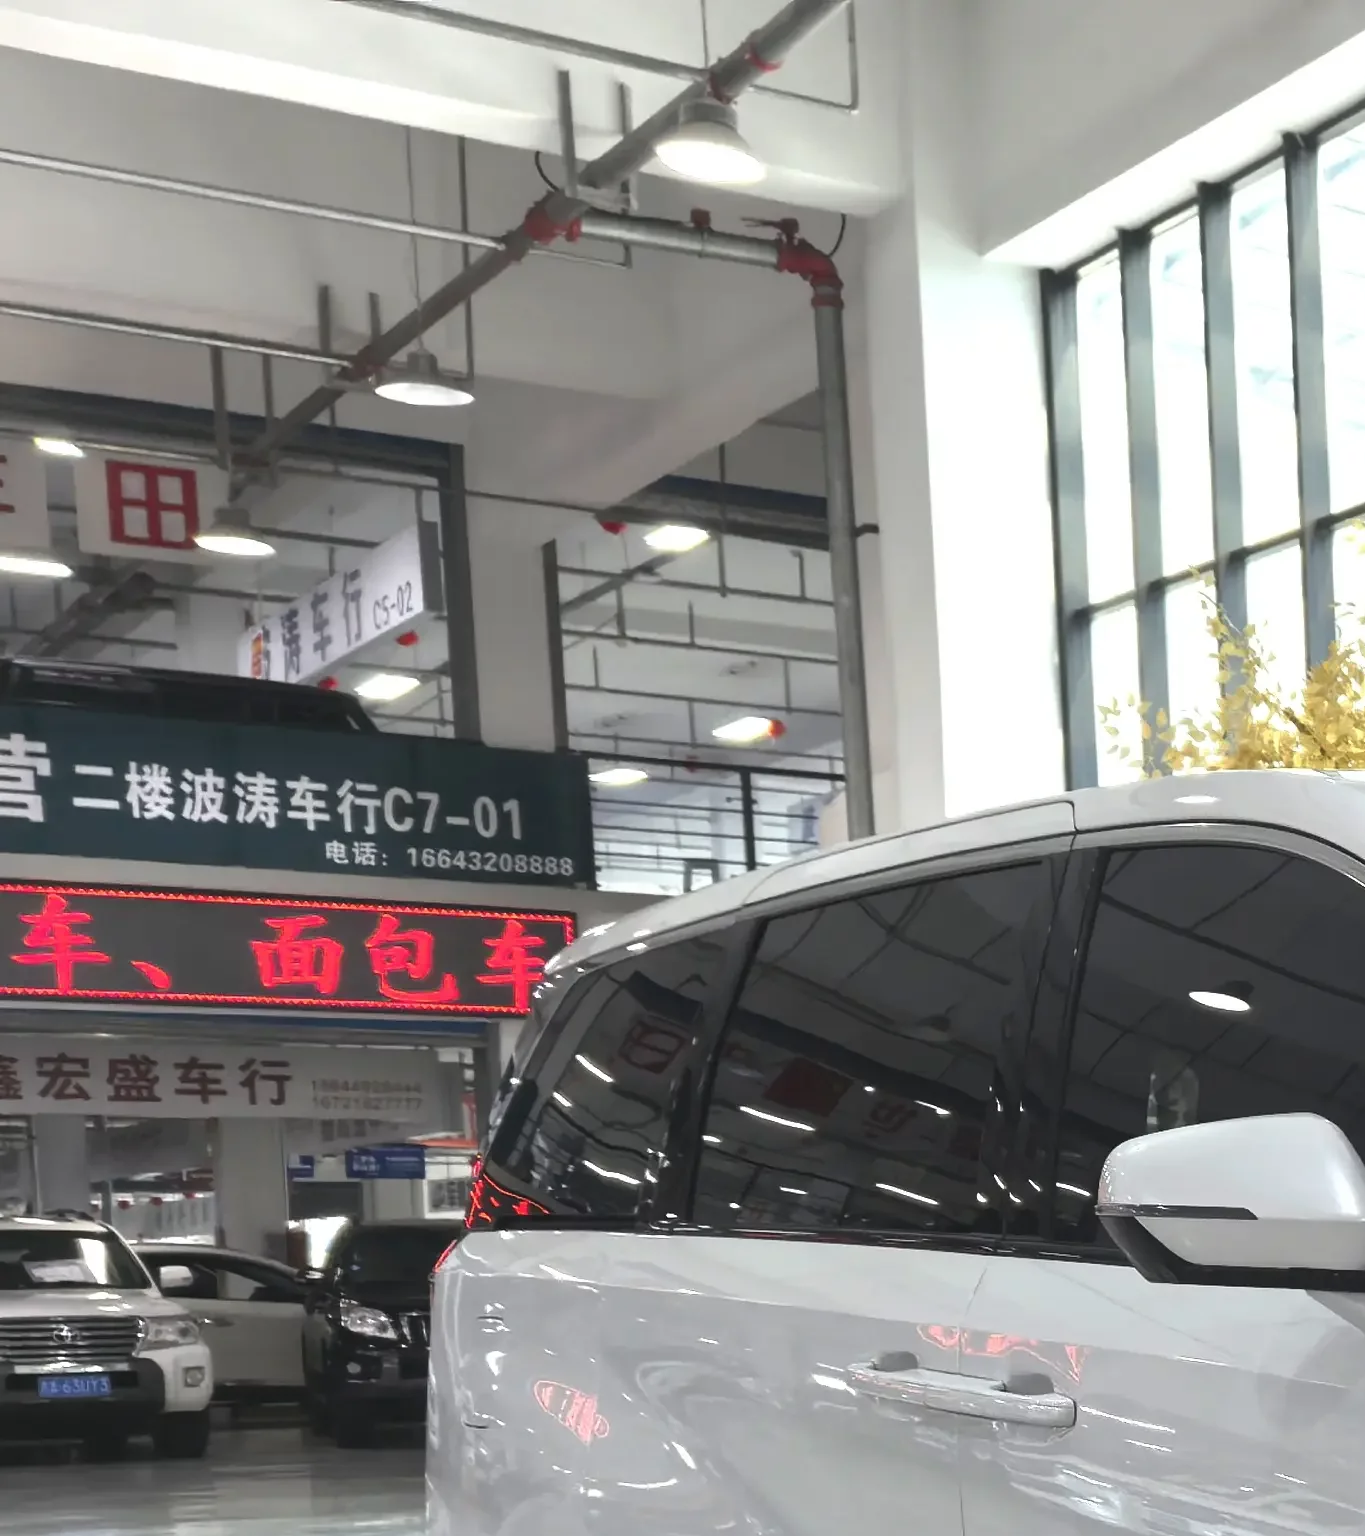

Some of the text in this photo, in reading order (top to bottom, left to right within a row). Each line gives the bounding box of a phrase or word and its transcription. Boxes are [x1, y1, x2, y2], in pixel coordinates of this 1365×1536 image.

[105, 459, 199, 549] 田
[73, 761, 523, 841] 二楼波涛车行C7-01
[407, 849, 573, 877] 16643208888
